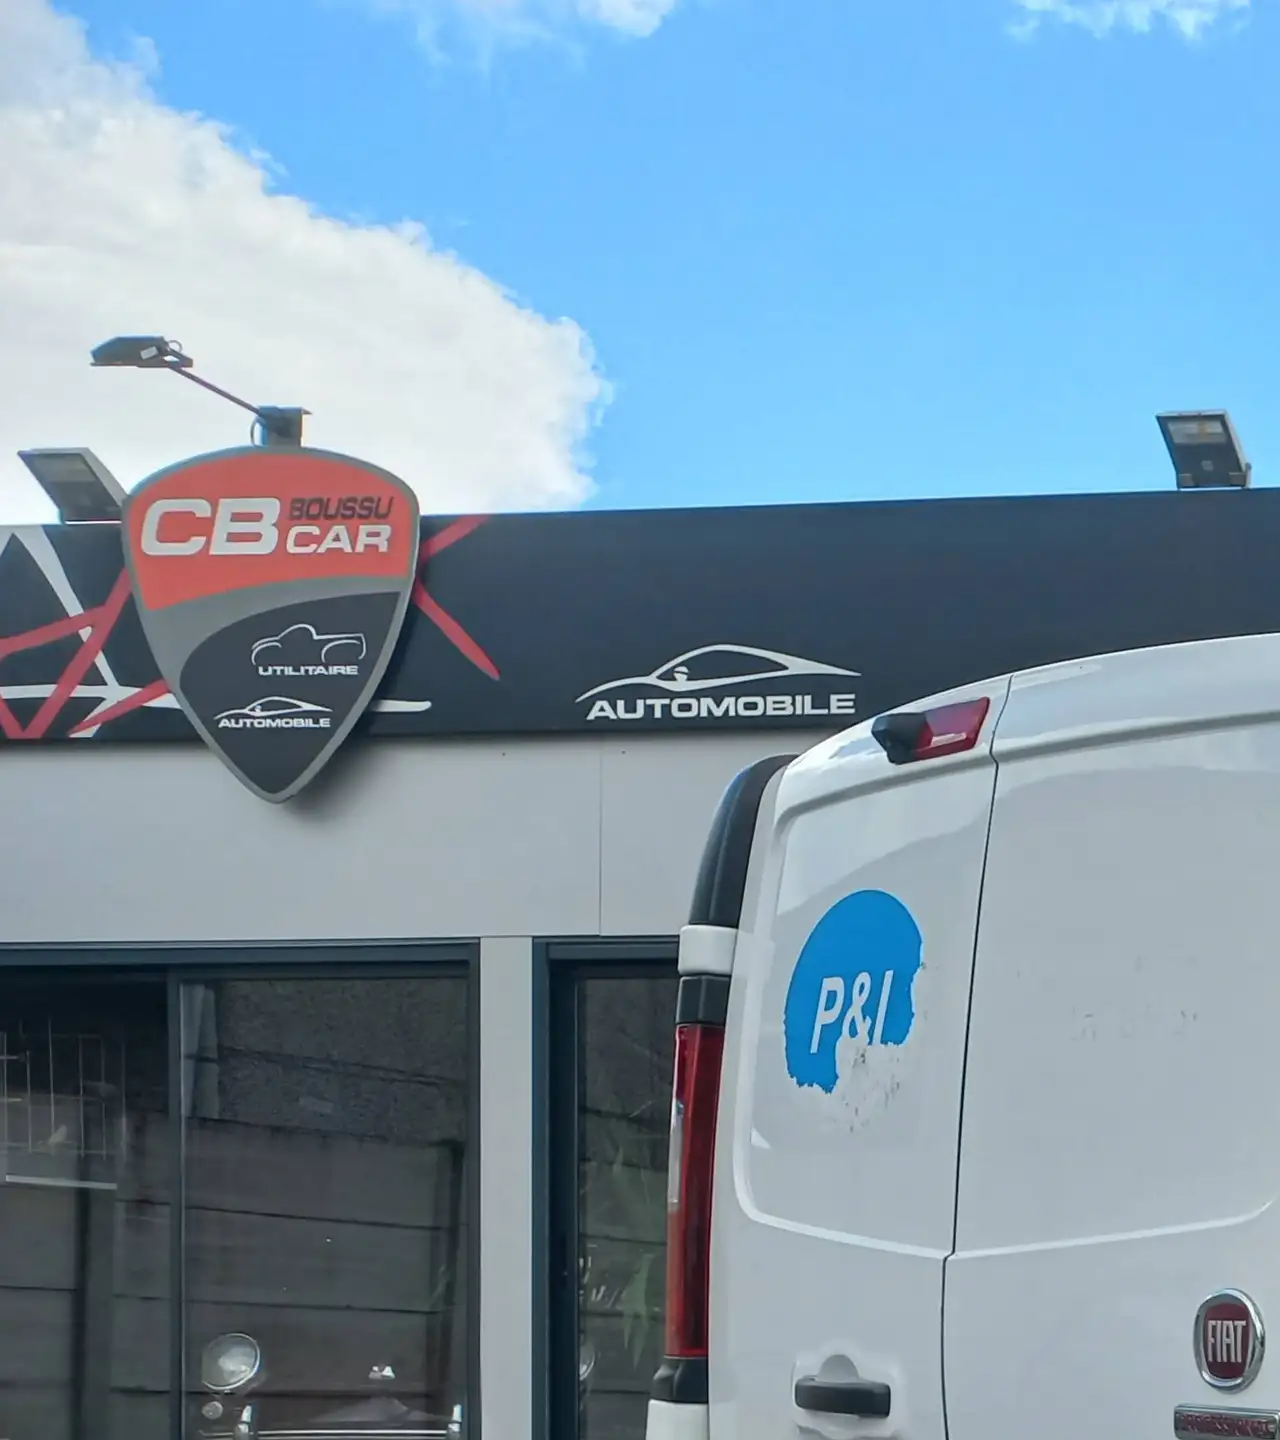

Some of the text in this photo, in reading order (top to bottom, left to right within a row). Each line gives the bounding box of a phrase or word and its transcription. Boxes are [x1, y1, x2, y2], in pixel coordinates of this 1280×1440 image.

[288, 496, 395, 520] BOUSSU
[140, 497, 392, 556] CB CAR
[257, 665, 360, 676] UTILITAIRE
[586, 693, 856, 721] AUTOMOBILE
[218, 717, 331, 729] AUTOMOBILE
[1207, 1319, 1247, 1363] FIAT
